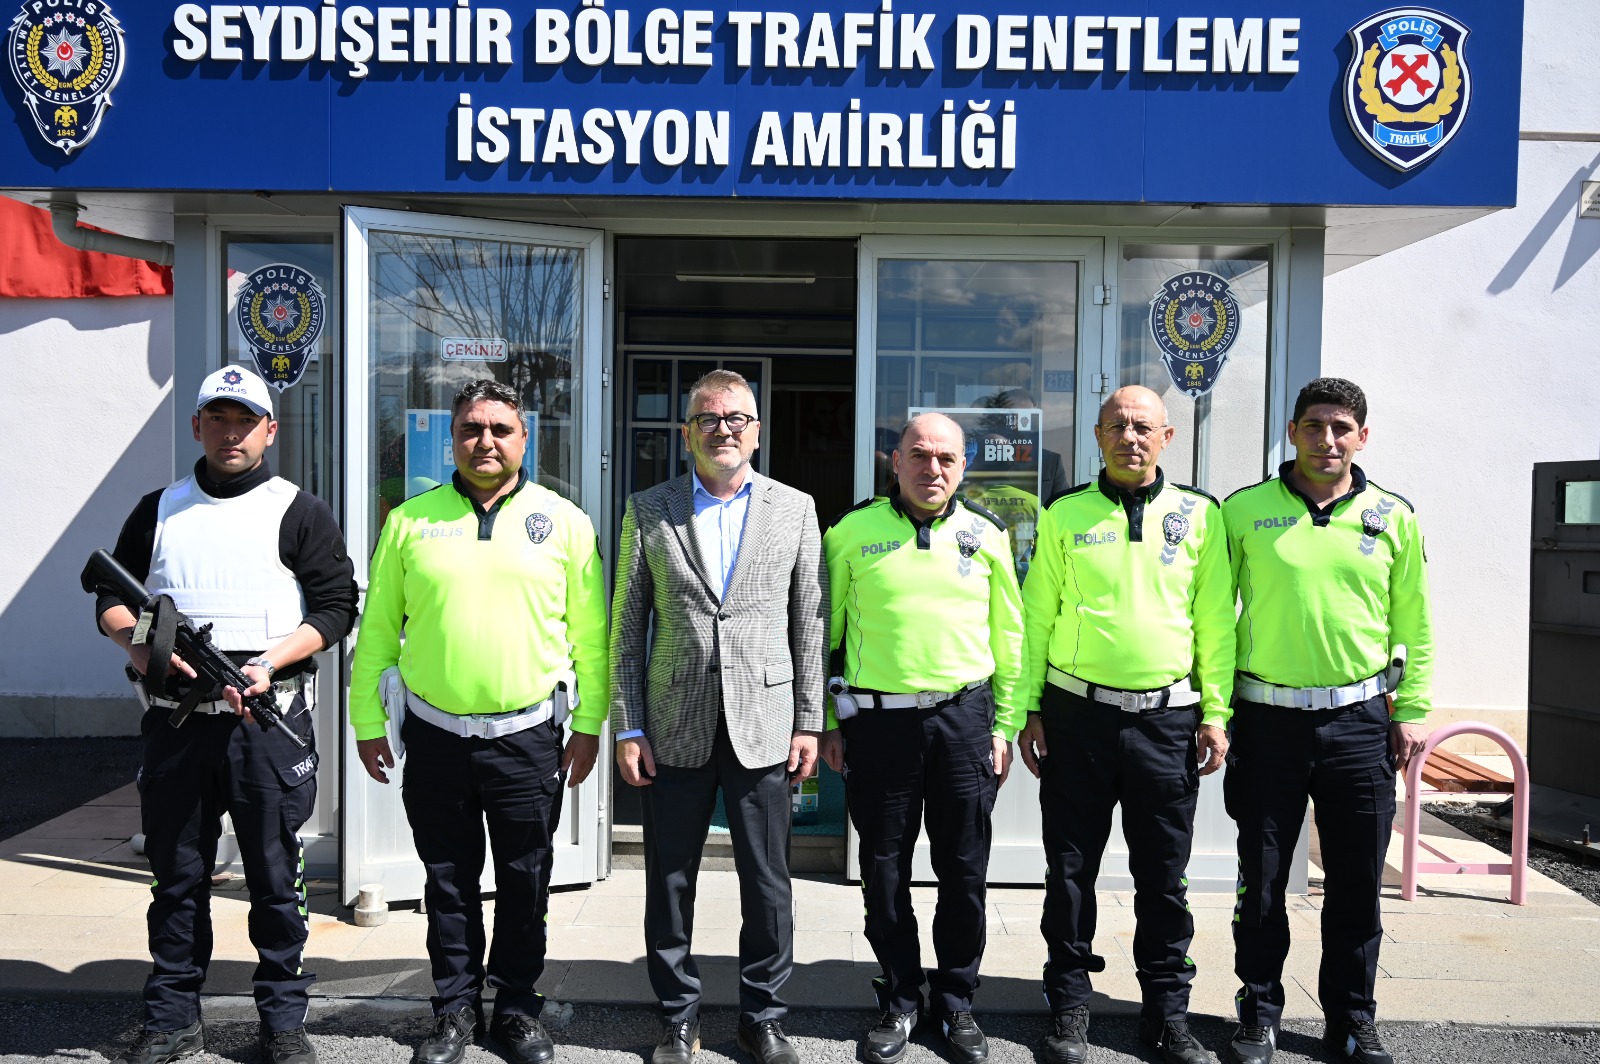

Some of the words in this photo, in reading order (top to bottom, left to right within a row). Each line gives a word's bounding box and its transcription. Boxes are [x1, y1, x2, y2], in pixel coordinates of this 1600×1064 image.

[1387, 20, 1435, 35] POLİS
[173, 0, 513, 78] SEYDİŞEHİR
[535, 0, 714, 66] BÖLGE
[728, 0, 936, 71] TRAFİK
[955, 14, 1301, 74] DENETLEME
[44, 89, 86, 101] GENEL
[57, 129, 76, 137] 1845
[457, 93, 730, 166] İSTASYON
[751, 98, 1017, 170] AMİRLİĞİ
[1389, 132, 1428, 145] TRAFİK
[255, 268, 306, 285] POLİS
[1170, 275, 1223, 292] POLİS
[264, 342, 297, 352] GENEL
[446, 341, 503, 357] ÇEKİNİZ
[1178, 349, 1212, 359] GENEL
